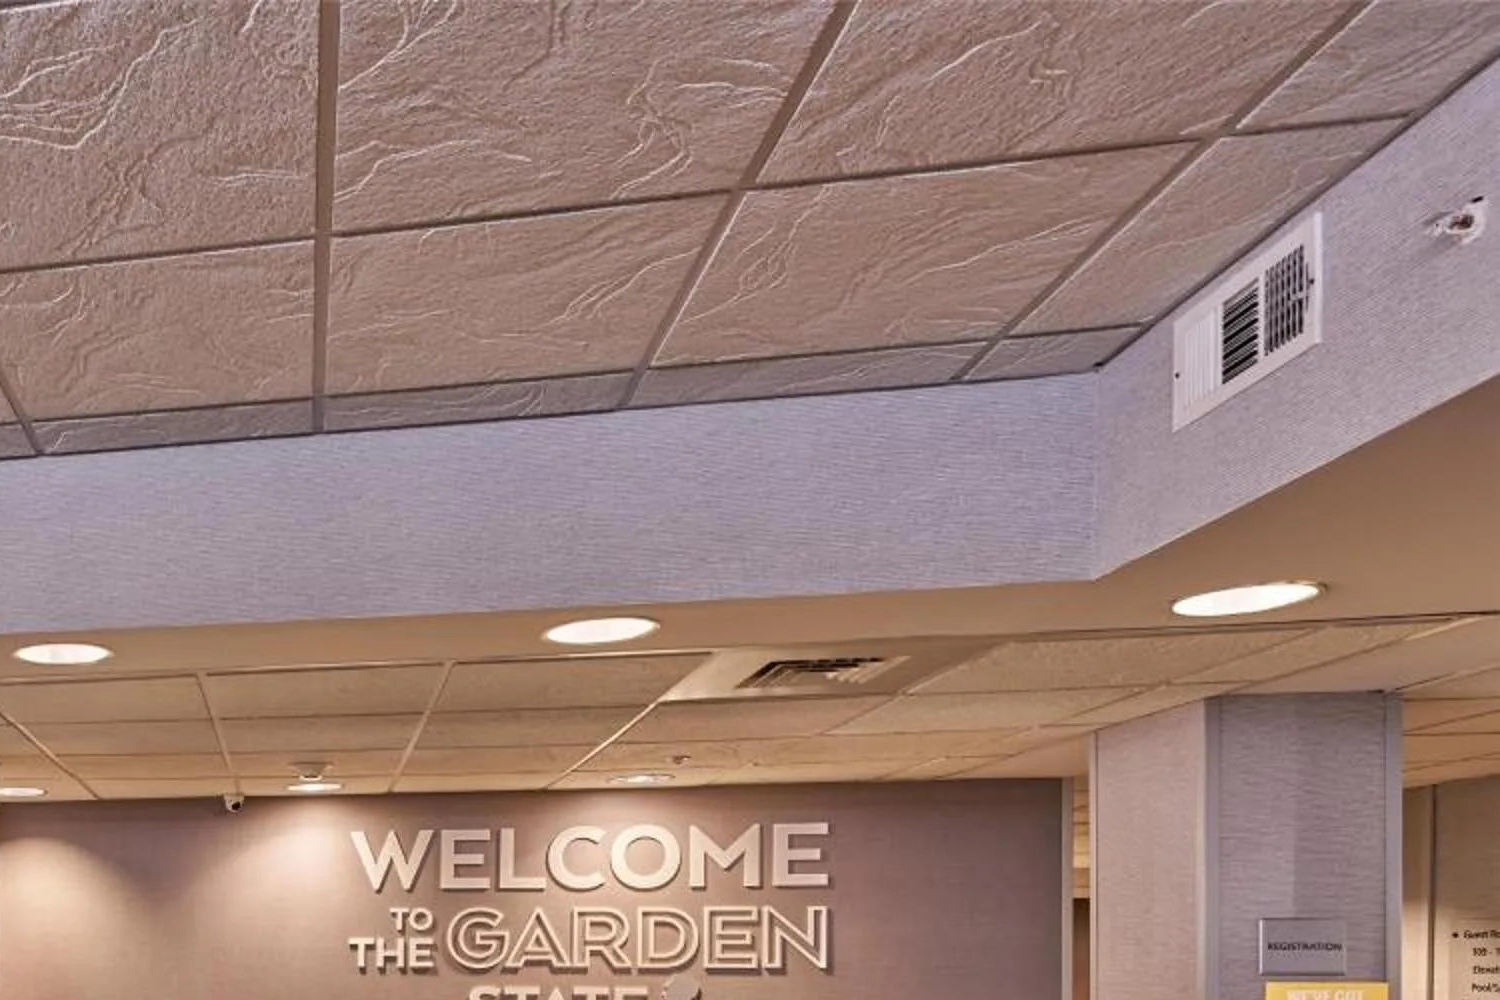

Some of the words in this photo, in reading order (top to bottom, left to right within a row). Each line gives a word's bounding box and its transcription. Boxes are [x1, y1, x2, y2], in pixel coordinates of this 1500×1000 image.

[350, 822, 830, 891] WELCOME
[348, 937, 435, 969] THE
[446, 904, 828, 970] GARDEN
[390, 907, 434, 931] TO
[1267, 942, 1343, 951] REGISTRATION
